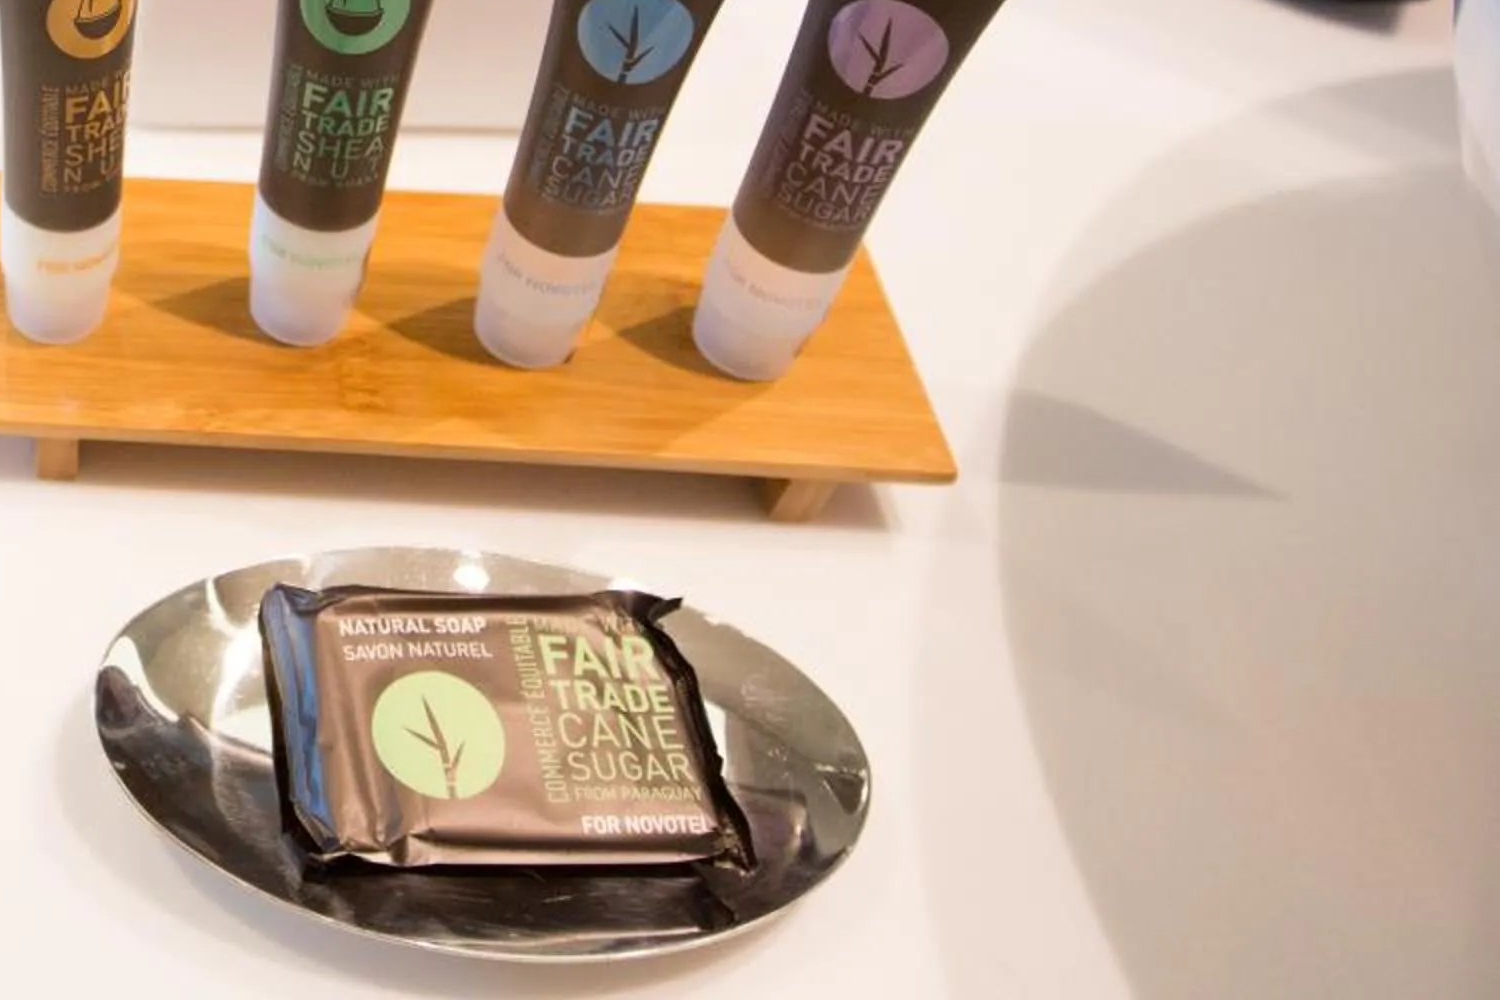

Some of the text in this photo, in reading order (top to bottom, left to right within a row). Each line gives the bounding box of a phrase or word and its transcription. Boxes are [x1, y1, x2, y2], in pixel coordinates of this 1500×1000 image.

[303, 82, 394, 117] FAIR
[302, 109, 389, 137] TRADE
[564, 105, 659, 148] FAIR
[804, 114, 903, 165] FAIR
[297, 130, 384, 160] SHEA
[561, 134, 647, 167] TRADE
[801, 141, 892, 183] TRADE
[552, 156, 642, 190] CANE
[787, 161, 881, 205] CANE
[778, 182, 872, 223] SUGAR
[339, 616, 487, 637] NATURAL SOAP
[344, 641, 494, 661] SAVON NATUREL
[537, 634, 661, 681] FAIR
[548, 679, 675, 713] TRADE
[558, 711, 684, 750] CANE
[525, 703, 570, 803] COMMERCE
[567, 750, 695, 782] SUGAR
[574, 785, 702, 800] FROM PARAGUAY
[581, 814, 710, 835] FOR NOVOTEL
